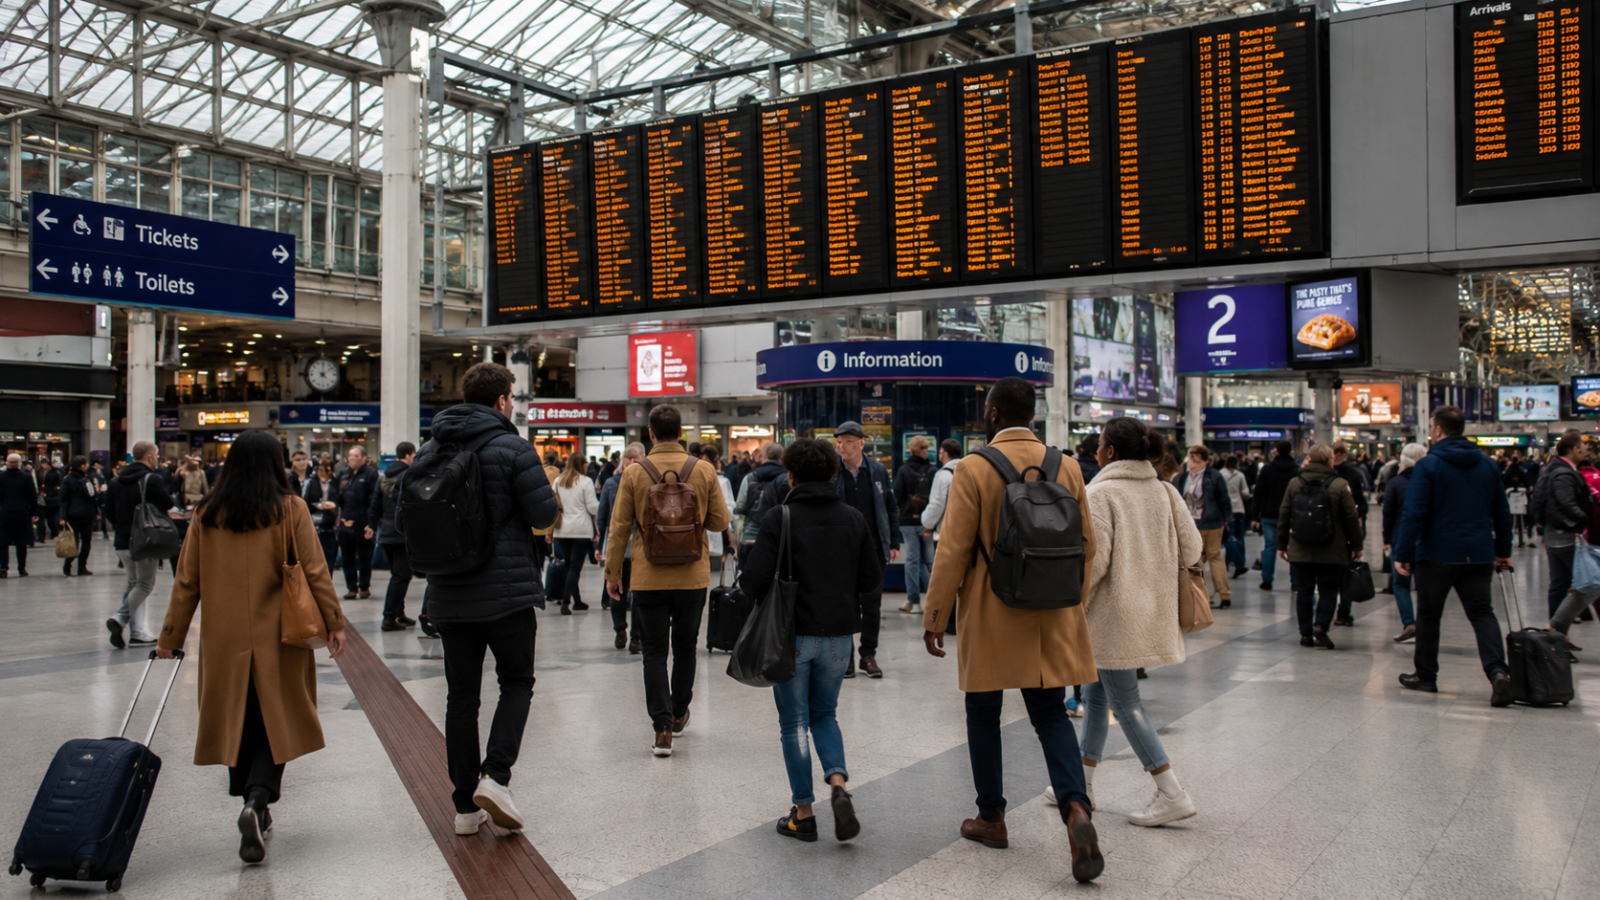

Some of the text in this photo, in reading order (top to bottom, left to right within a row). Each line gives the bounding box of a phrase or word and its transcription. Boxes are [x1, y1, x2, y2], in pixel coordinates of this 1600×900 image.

[1470, 2, 1512, 16] Arrivals
[135, 224, 199, 250] Tickets
[135, 271, 195, 295] Toilets
[1309, 286, 1328, 298] PASTY
[1330, 283, 1352, 295] THAT'S
[1207, 293, 1237, 345] 2
[843, 350, 943, 368] Information
